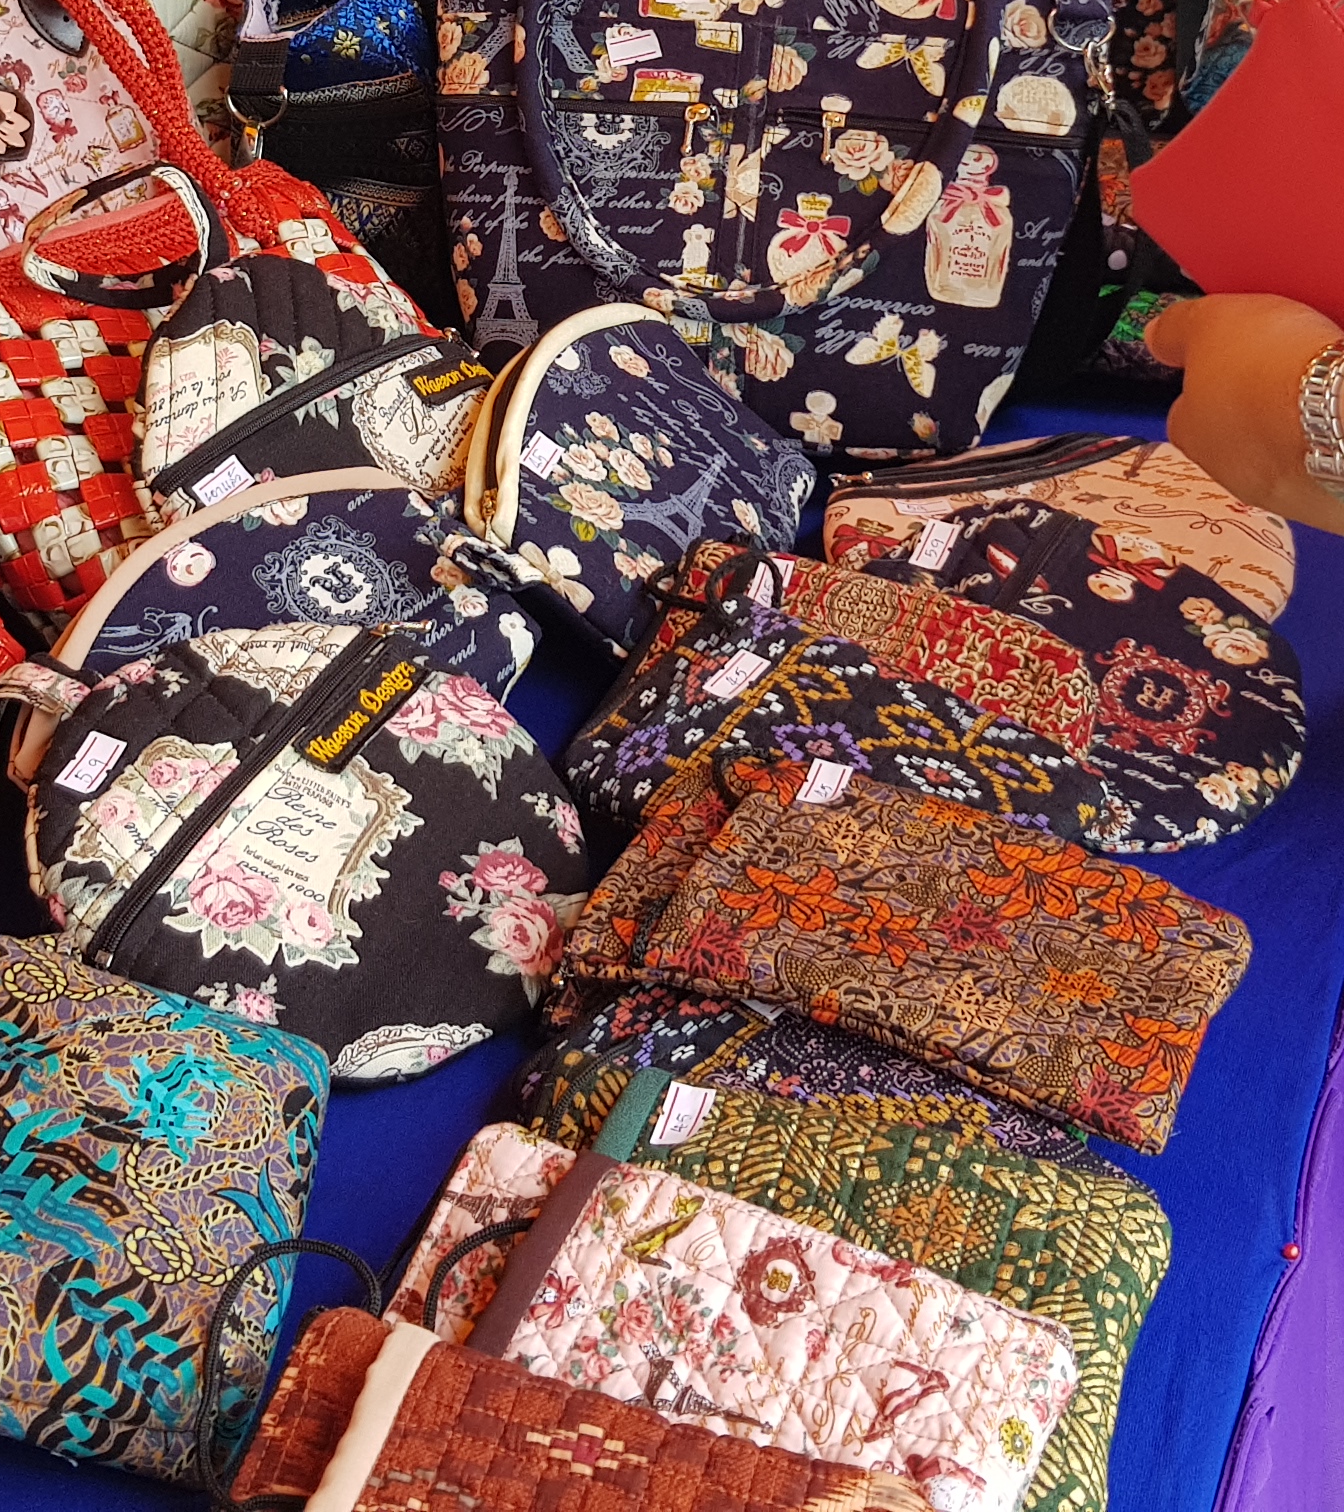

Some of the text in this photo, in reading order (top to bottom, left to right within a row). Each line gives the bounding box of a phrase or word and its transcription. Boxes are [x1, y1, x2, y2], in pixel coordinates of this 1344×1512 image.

[358, 660, 418, 714] Design
[74, 755, 108, 785] 59
[266, 785, 338, 830] Reine
[275, 814, 315, 838] des
[245, 819, 320, 865] Roses
[287, 881, 326, 904] 1900
[670, 1112, 693, 1134] 45
